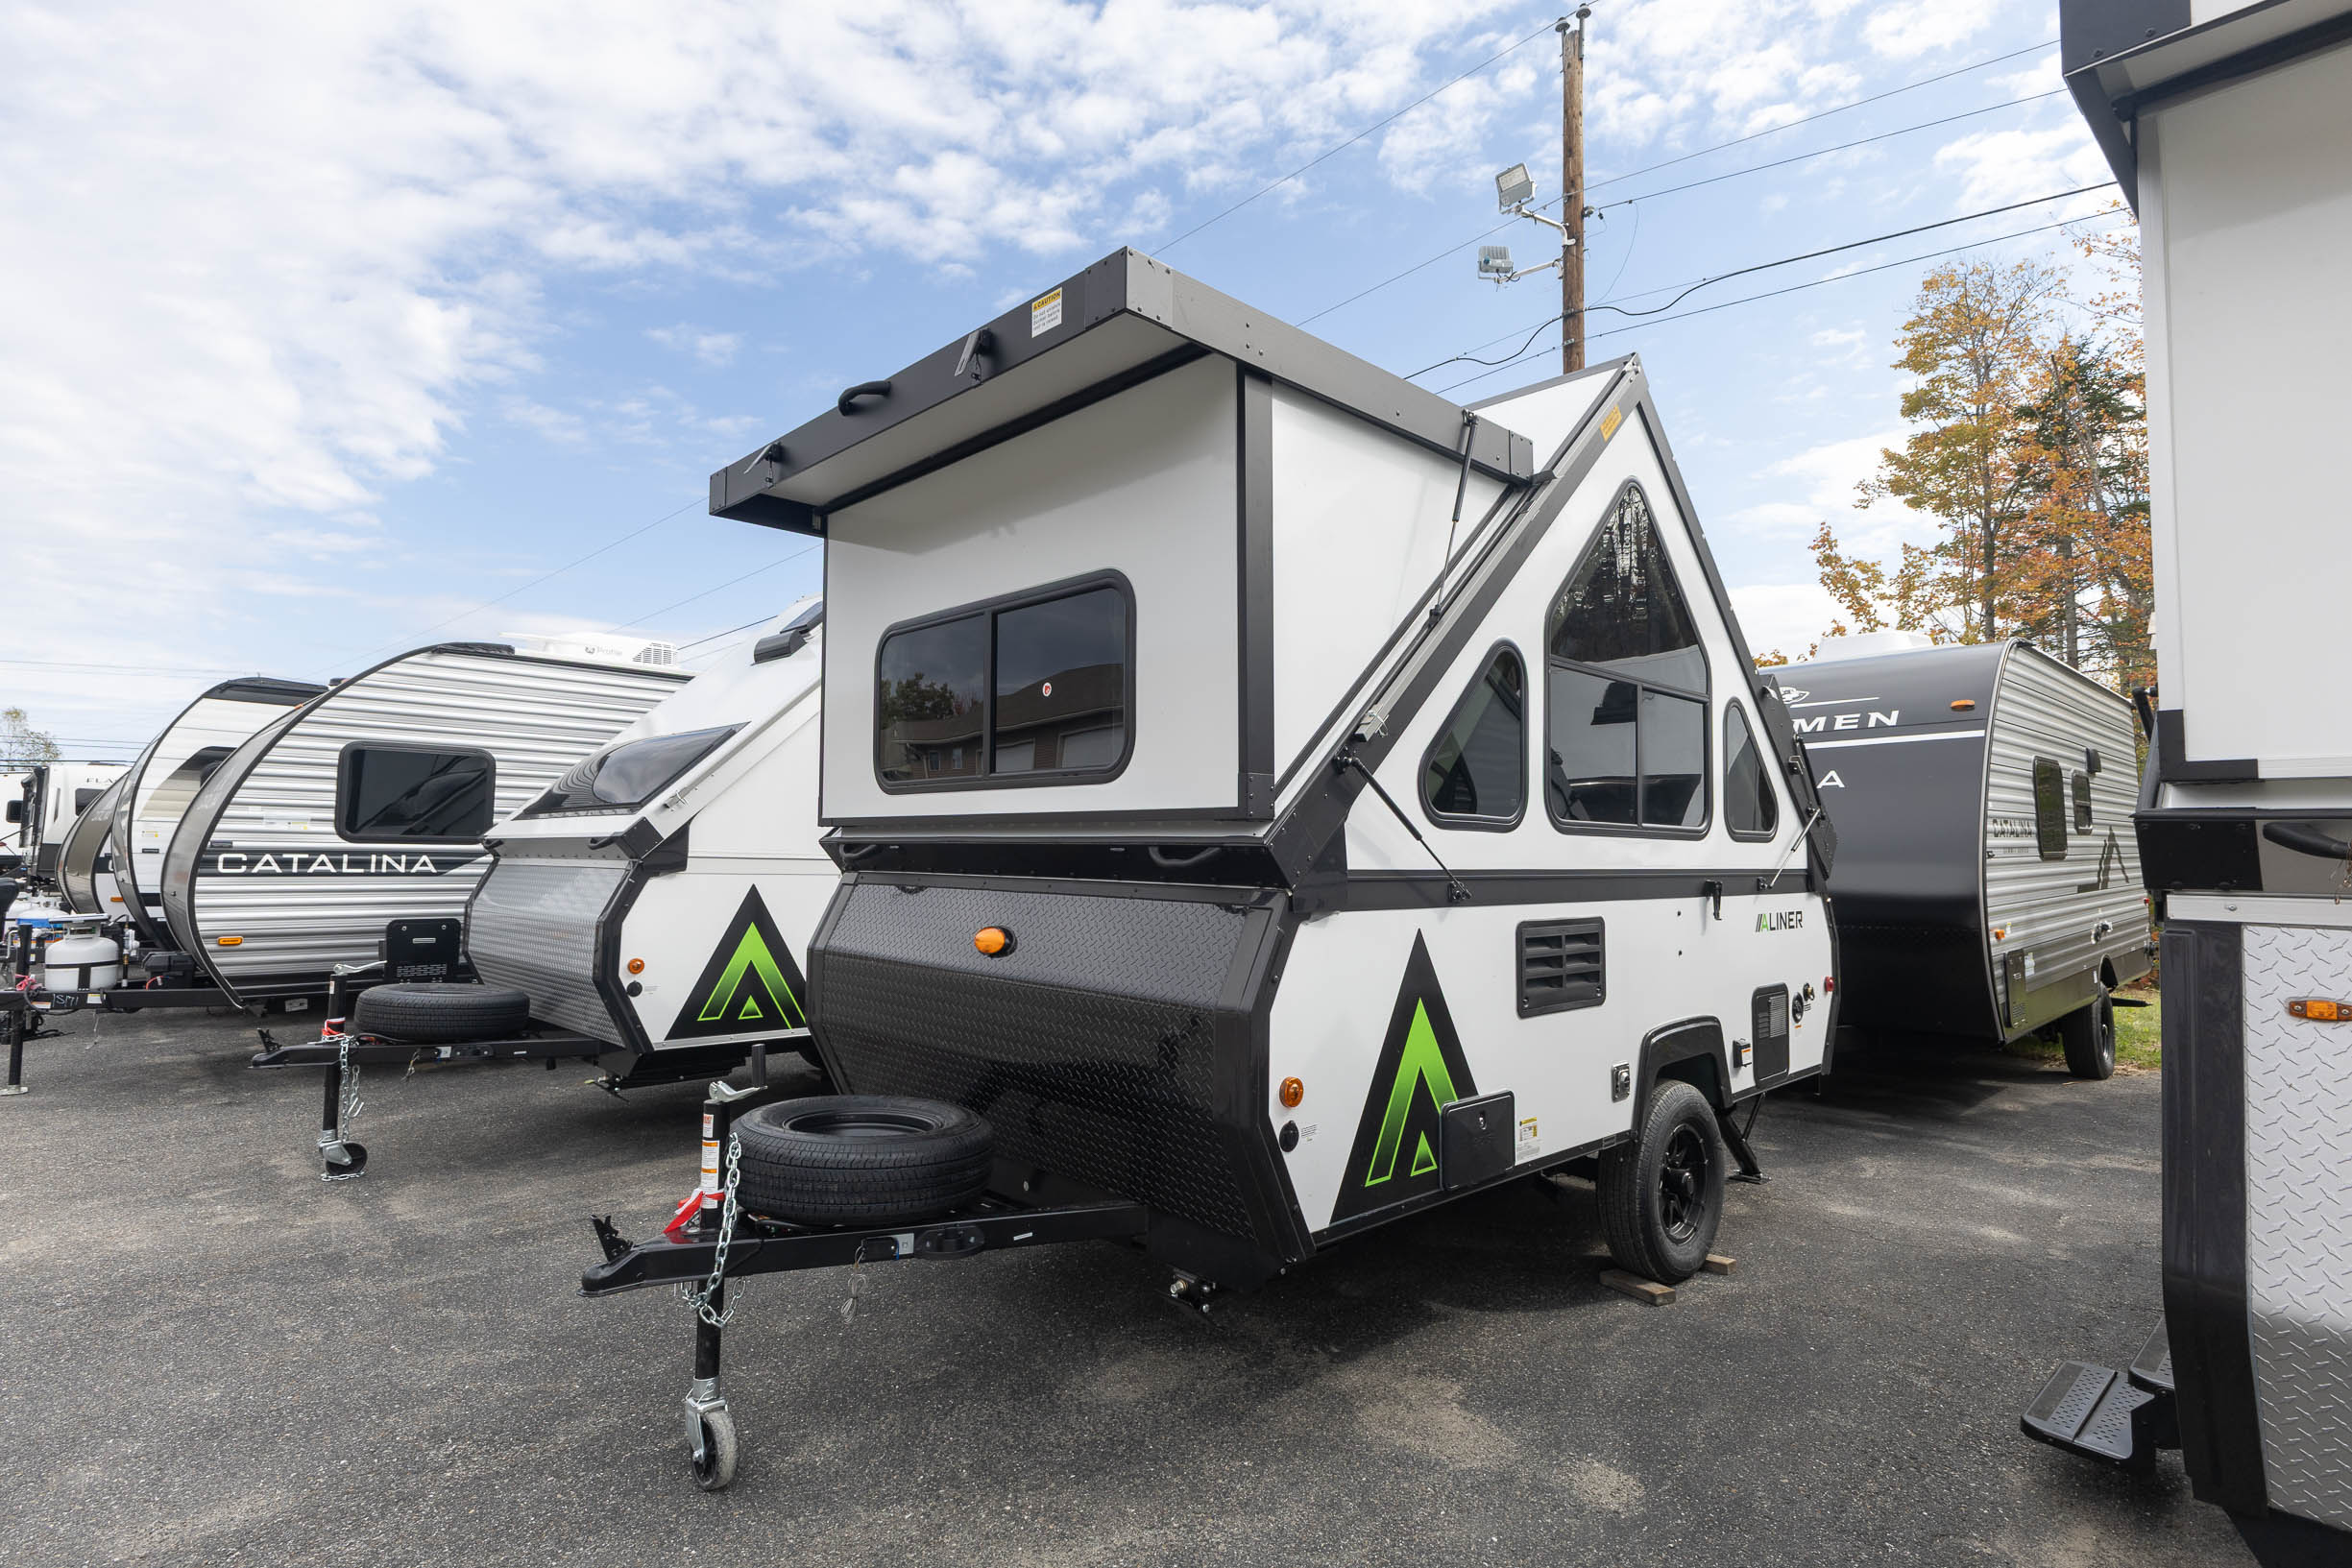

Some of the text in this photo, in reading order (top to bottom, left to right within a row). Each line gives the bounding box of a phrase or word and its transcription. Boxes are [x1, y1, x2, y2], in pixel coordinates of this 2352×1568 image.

[1992, 818, 2032, 837] CATALINA
[217, 853, 438, 873] CATALINA
[1756, 910, 1803, 932] ALINER
